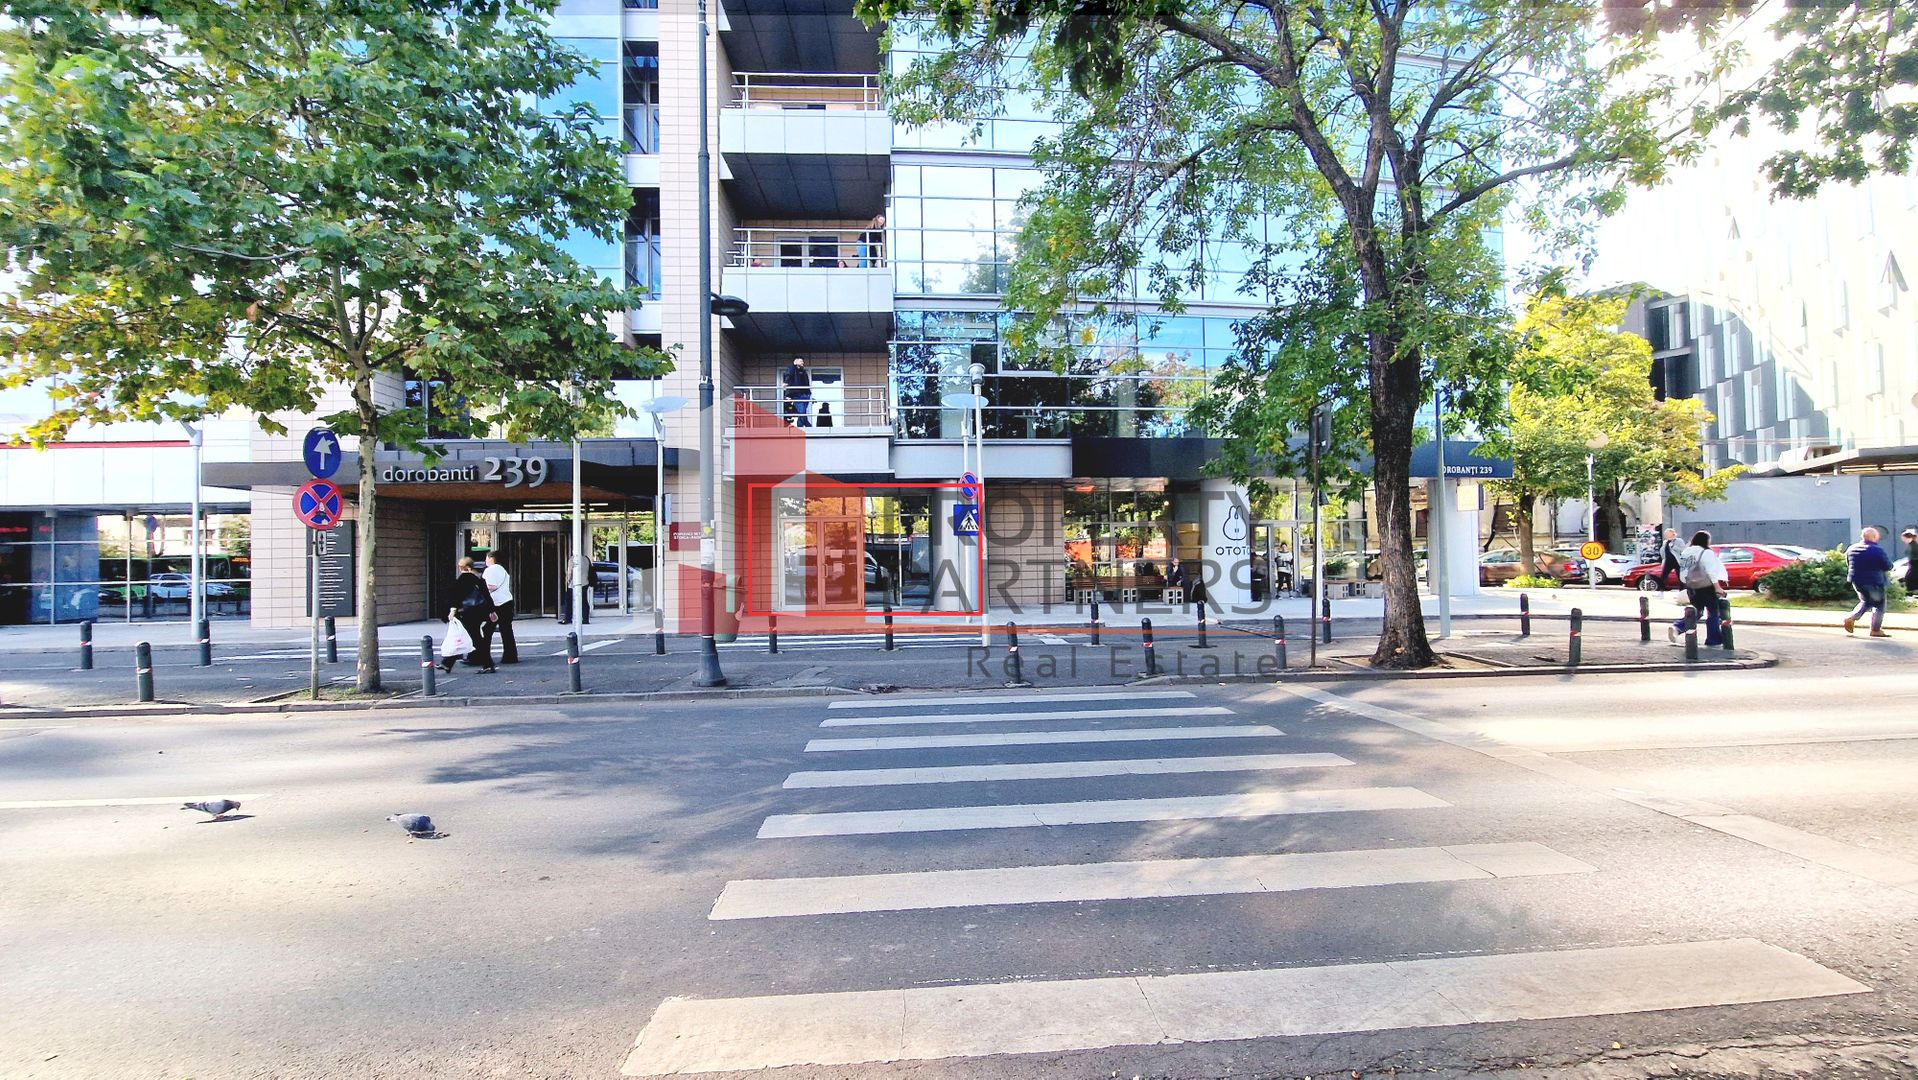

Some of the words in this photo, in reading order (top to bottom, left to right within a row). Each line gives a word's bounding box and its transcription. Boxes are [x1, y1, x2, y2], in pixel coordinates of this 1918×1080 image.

[484, 456, 547, 488] 239
[1480, 466, 1493, 474] 239
[1585, 546, 1600, 556] 30
